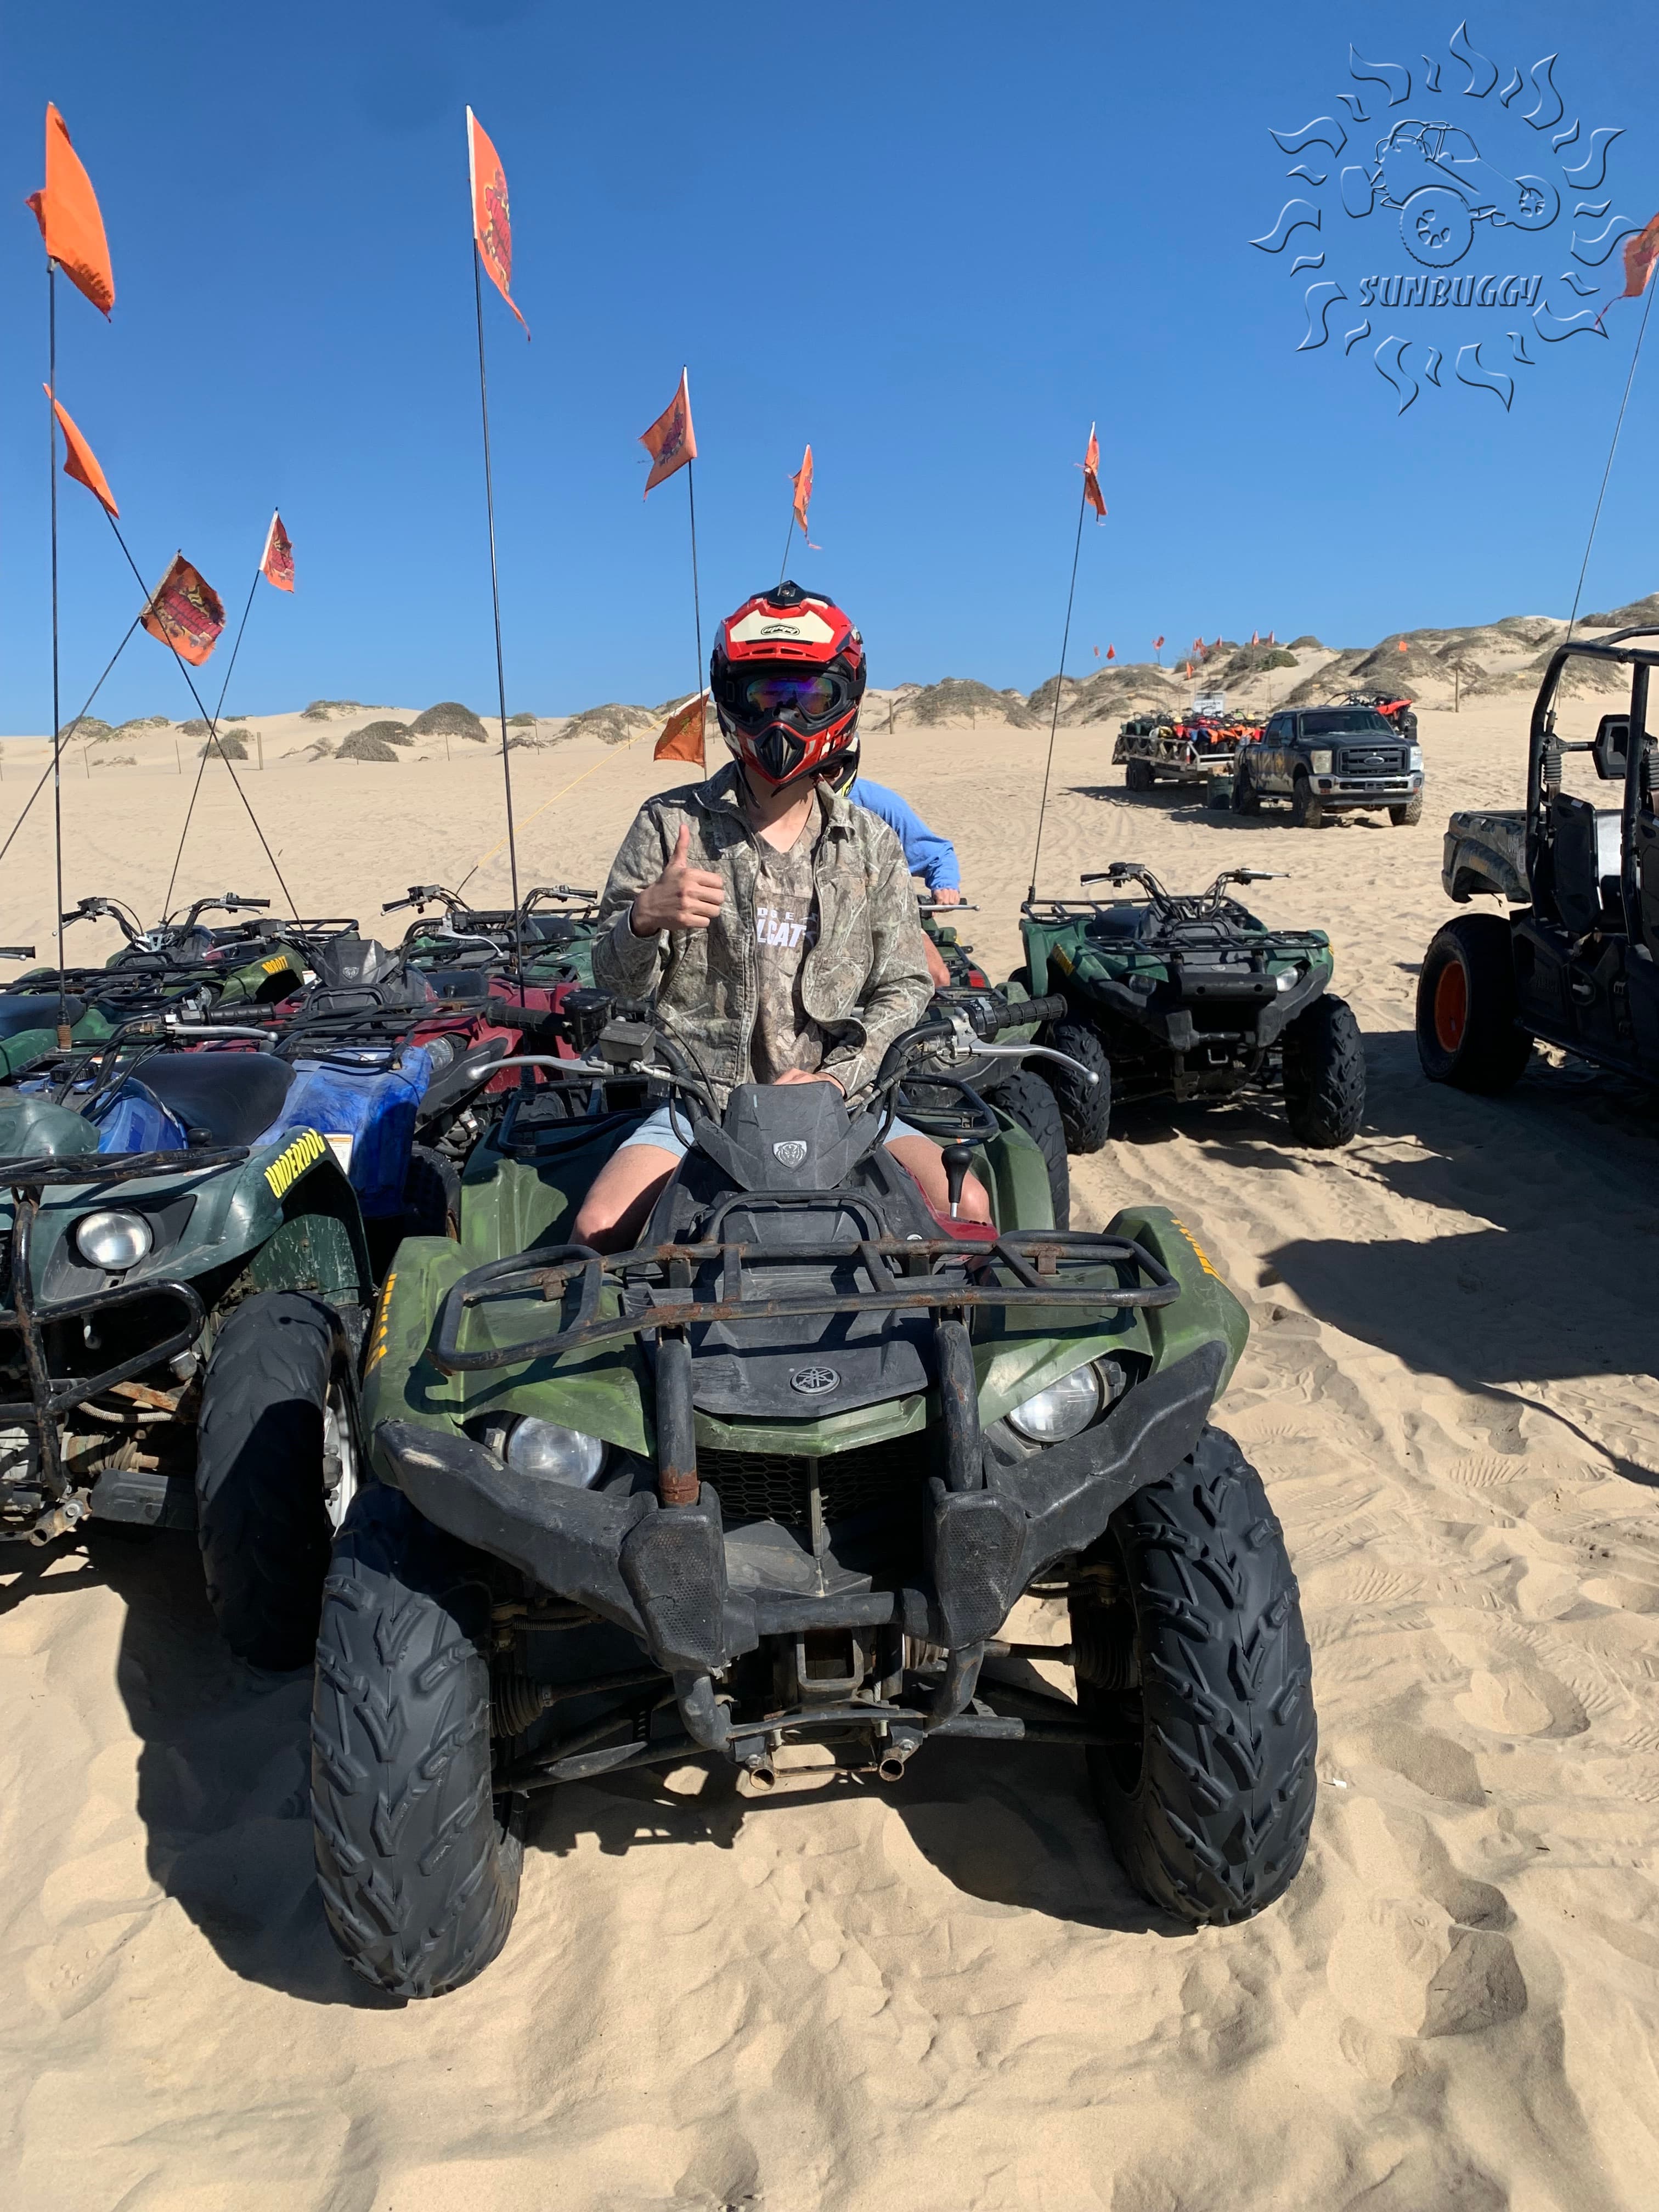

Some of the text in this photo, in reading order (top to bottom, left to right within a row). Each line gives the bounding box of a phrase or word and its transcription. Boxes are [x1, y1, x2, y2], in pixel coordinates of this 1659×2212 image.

[757, 907, 795, 921] DGE
[757, 918, 807, 947] LCAT
[264, 1127, 326, 1199] UNDERDOG
